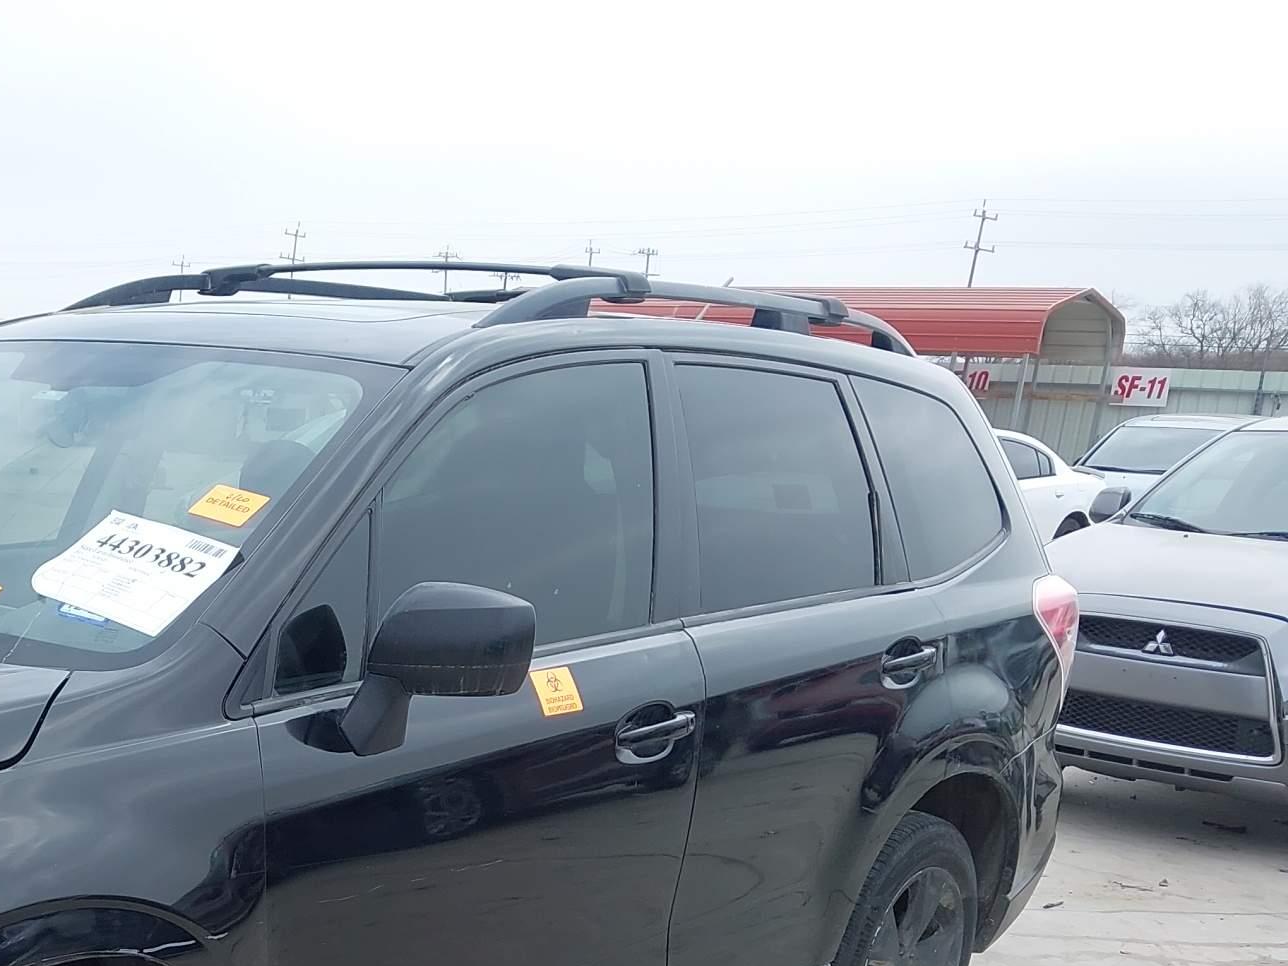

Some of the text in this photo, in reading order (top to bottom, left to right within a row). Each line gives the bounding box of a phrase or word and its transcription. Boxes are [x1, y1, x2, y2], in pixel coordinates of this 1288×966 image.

[968, 370, 989, 390] 10
[1114, 375, 1167, 399] SF-11
[206, 497, 250, 513] DETAILED
[96, 533, 206, 578] 44303882
